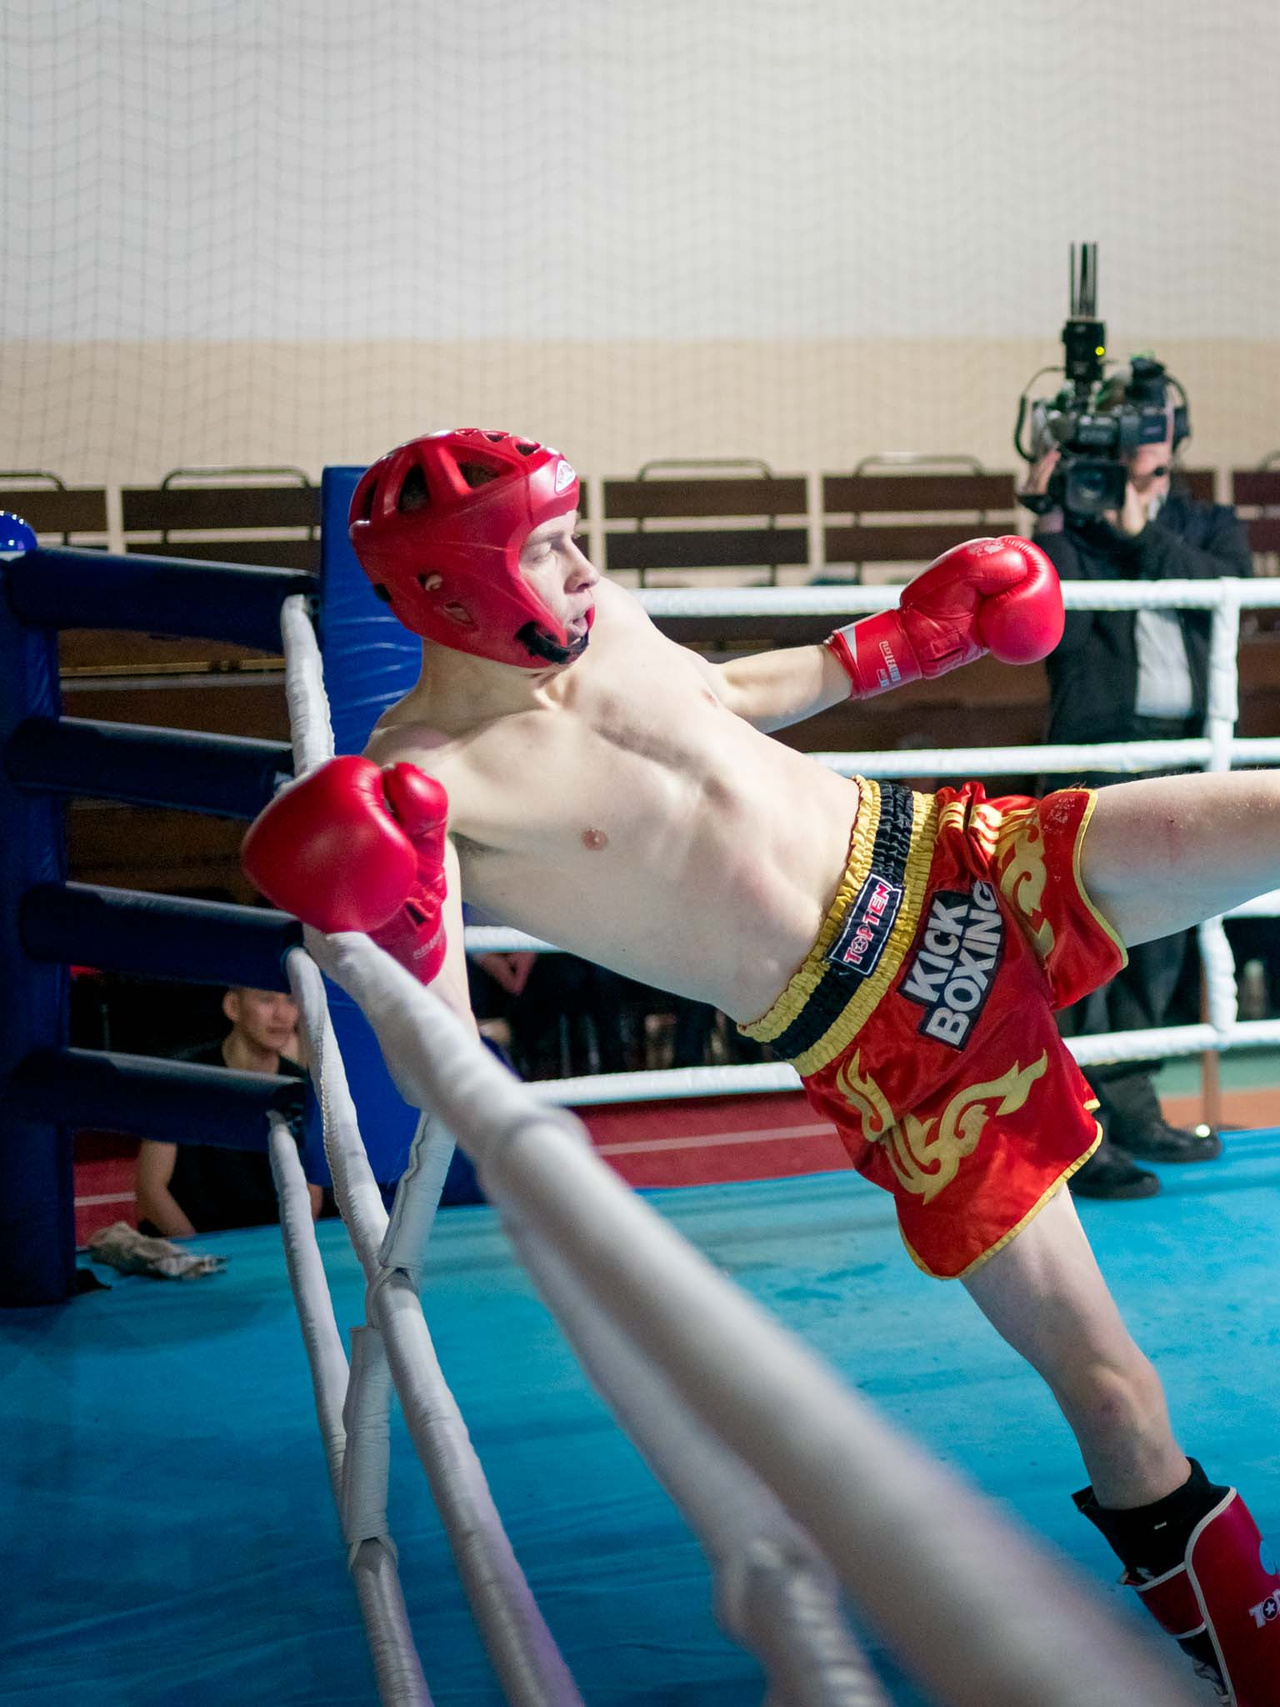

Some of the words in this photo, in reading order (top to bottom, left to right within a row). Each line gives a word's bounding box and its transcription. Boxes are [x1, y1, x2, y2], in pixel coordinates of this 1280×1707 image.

[843, 924, 875, 965] TOP
[862, 881, 890, 926] TEN
[903, 899, 969, 1003] KICK
[925, 880, 1002, 1046] BOXING
